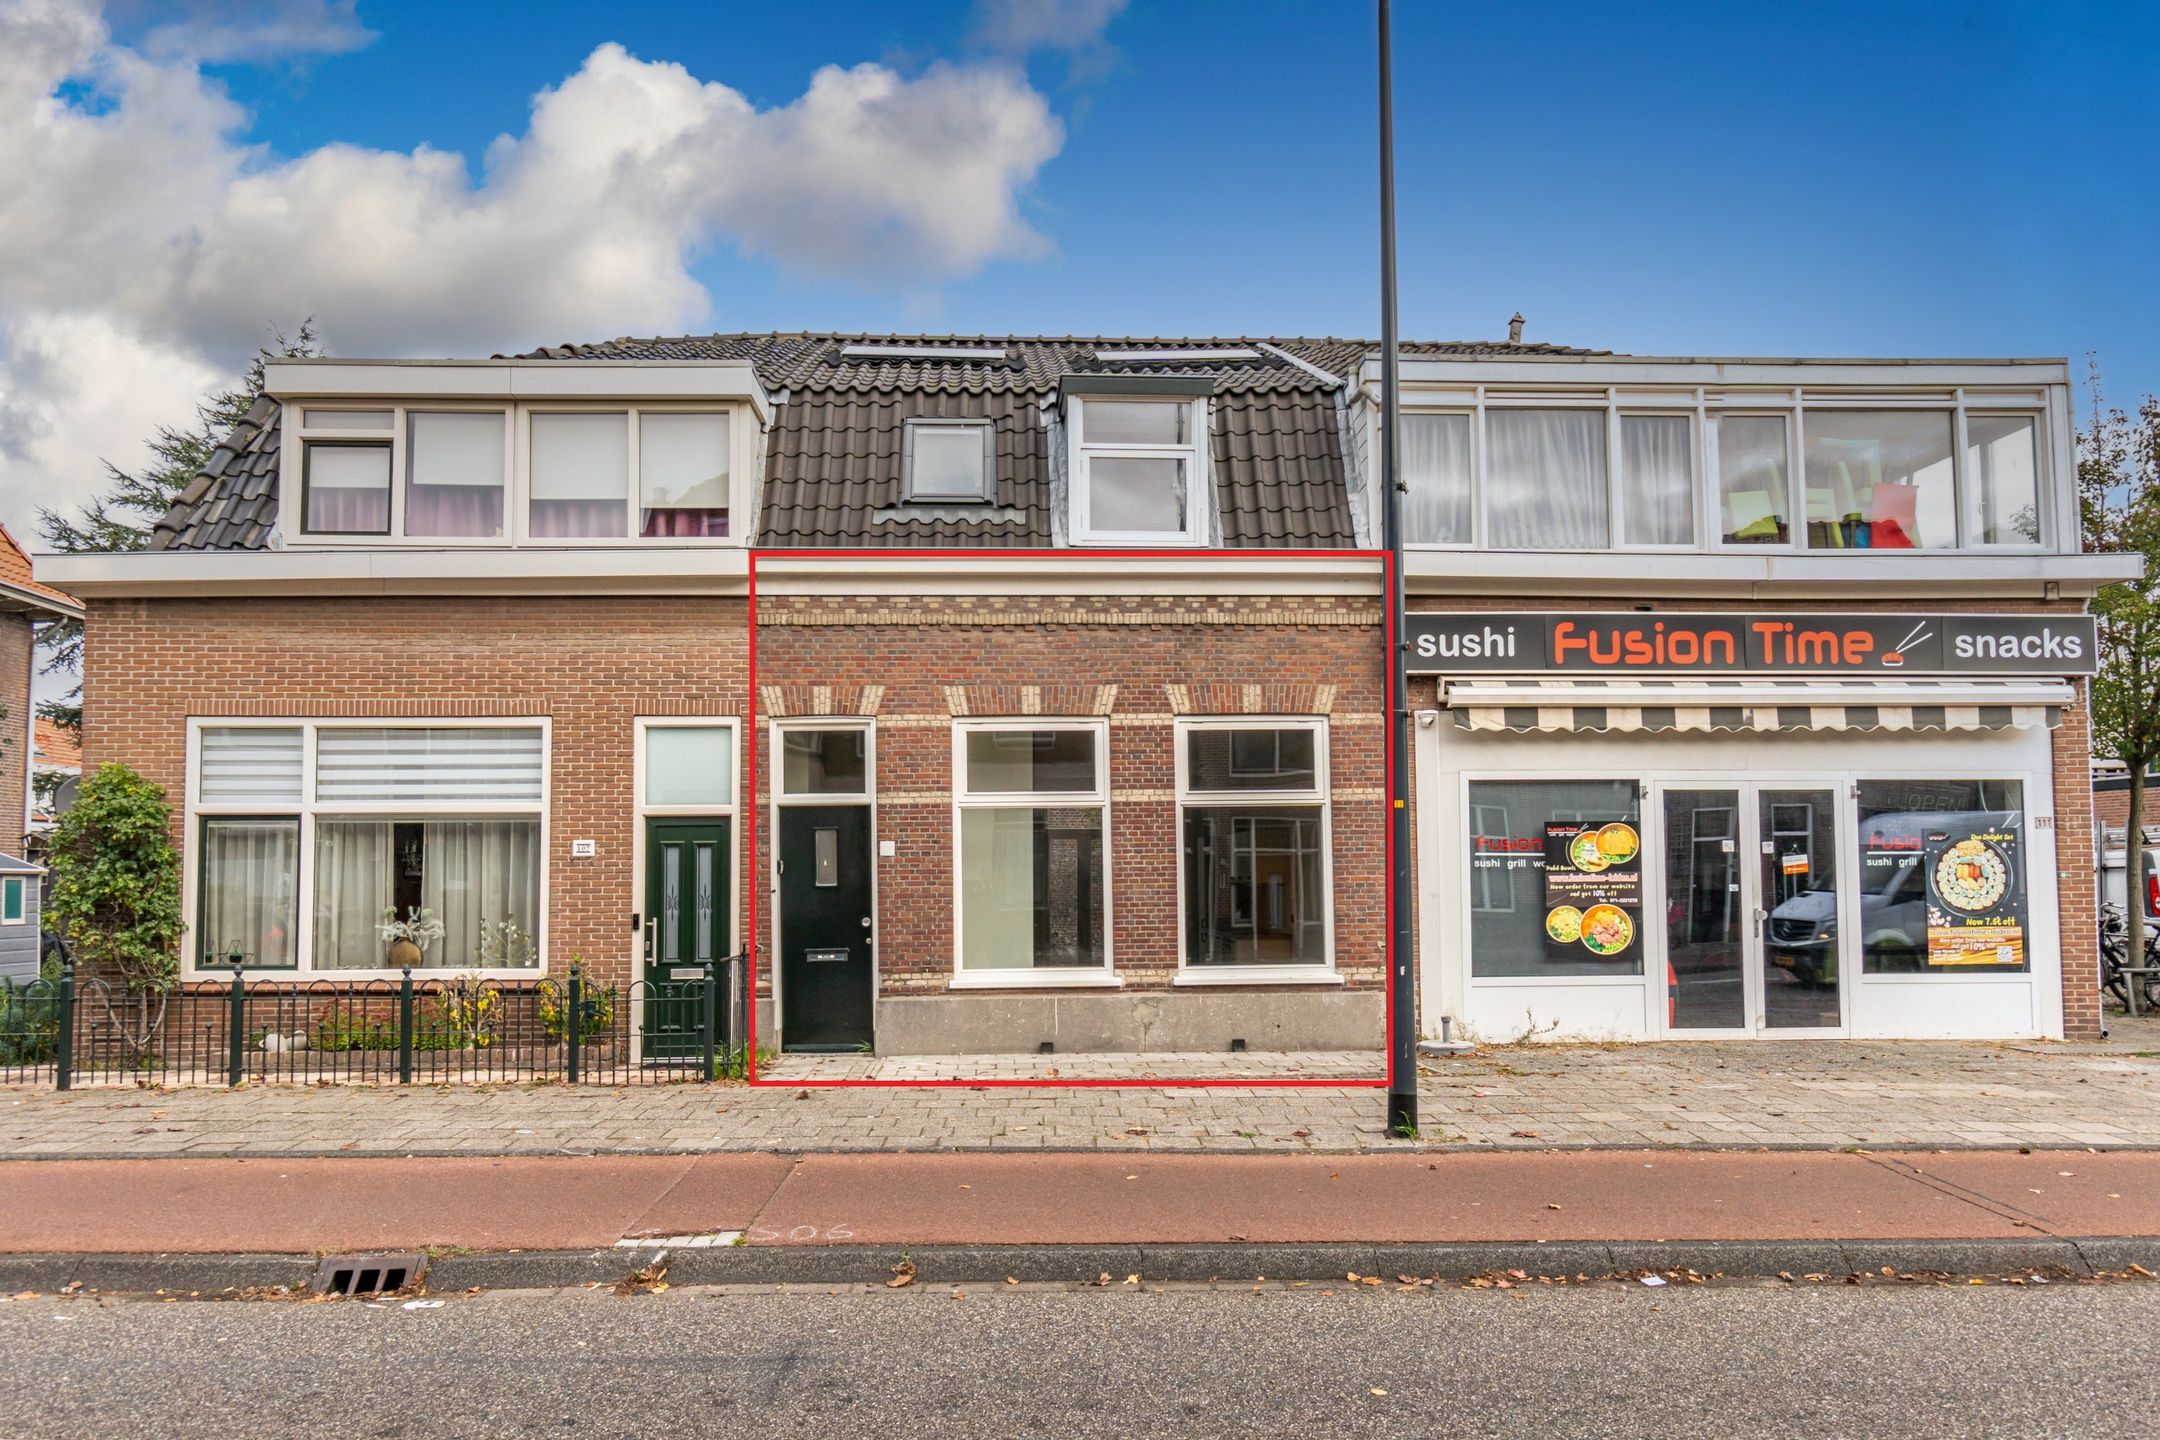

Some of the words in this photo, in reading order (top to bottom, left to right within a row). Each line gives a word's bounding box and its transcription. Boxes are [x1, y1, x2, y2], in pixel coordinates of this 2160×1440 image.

[1417, 626, 1515, 657] sushi
[1555, 622, 1735, 665] Fusion
[1752, 622, 1874, 665] Time
[1955, 628, 2083, 658] snacks
[1476, 834, 1544, 851] Fusion
[1474, 859, 1500, 868] sushi
[1507, 859, 1526, 870] grill
[1866, 857, 1892, 866] sushi
[1899, 857, 1917, 868] grill
[1966, 918, 1983, 926] Now
[2002, 916, 2015, 925] off
